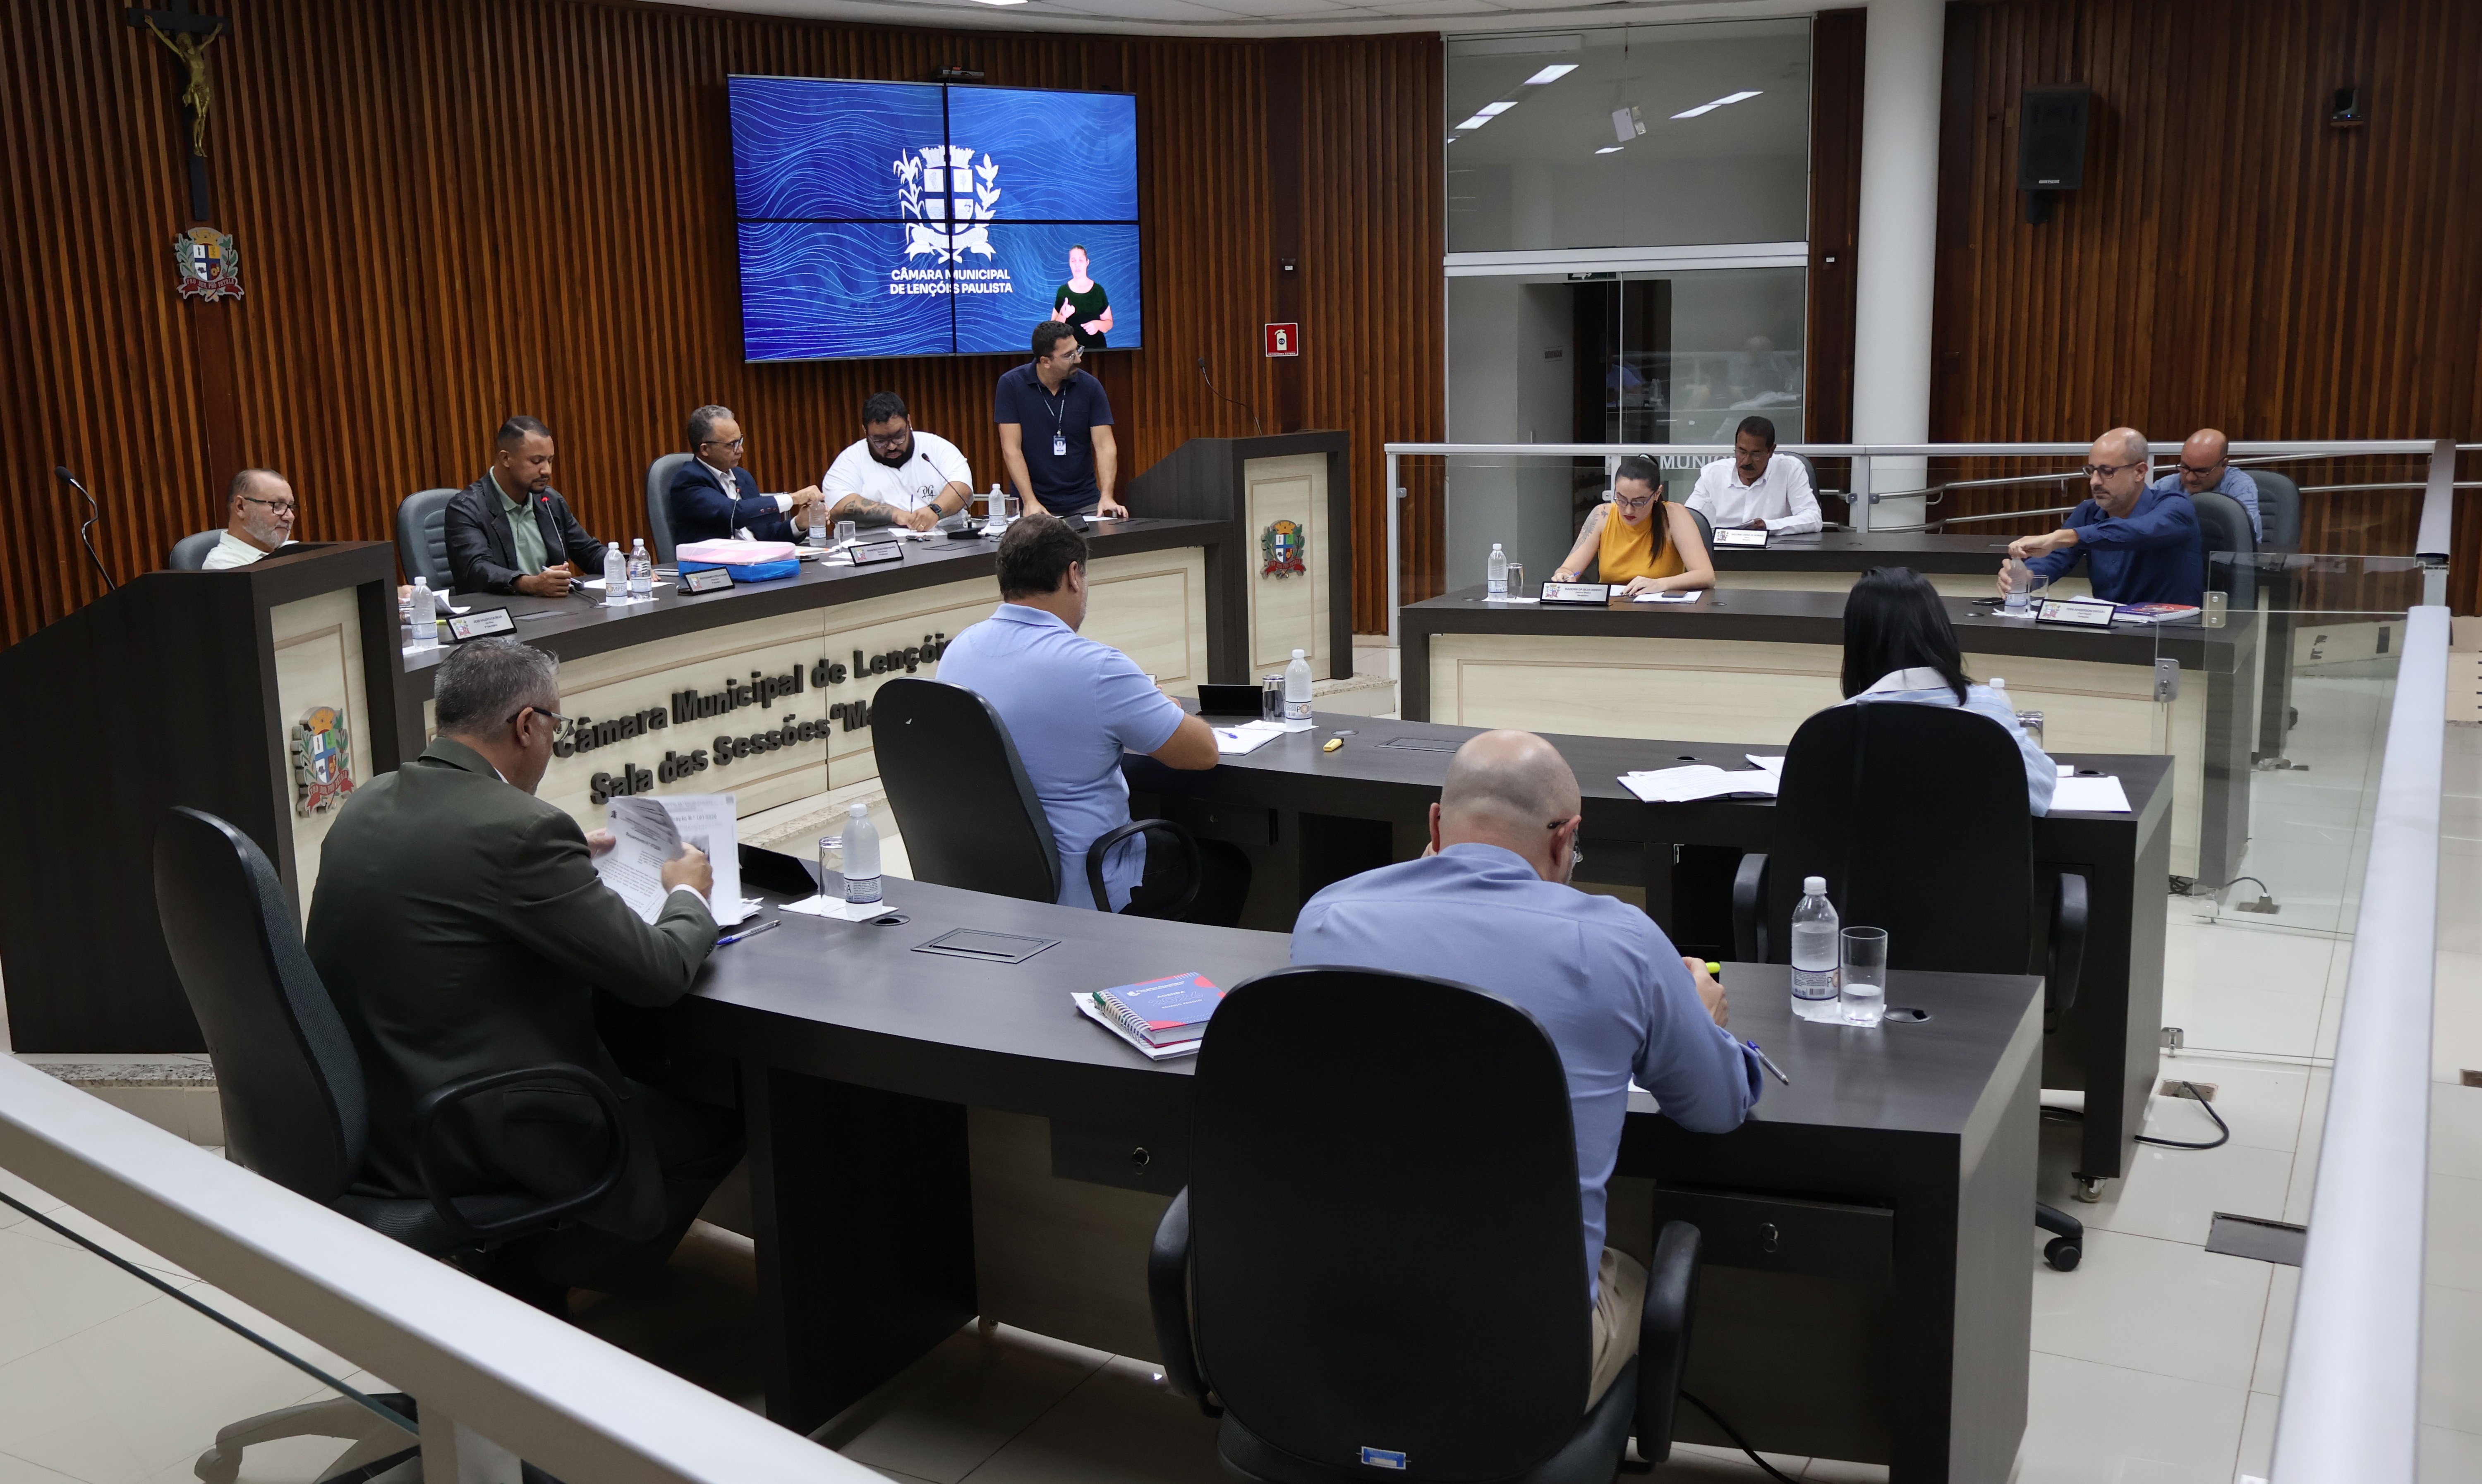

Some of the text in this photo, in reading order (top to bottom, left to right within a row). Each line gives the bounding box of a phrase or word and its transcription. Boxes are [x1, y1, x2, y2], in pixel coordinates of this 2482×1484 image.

[891, 267, 1011, 280] CÂMARA MUNICIPAL
[890, 280, 1013, 297] DE LENÇÓIS PAULISTA
[553, 707, 668, 758] Câmara
[672, 664, 803, 724] Municipal
[812, 658, 847, 688] de
[590, 763, 654, 804] Sala
[658, 749, 708, 783] das
[714, 714, 831, 766] Sessões
[1148, 991, 1204, 1007] 2026
